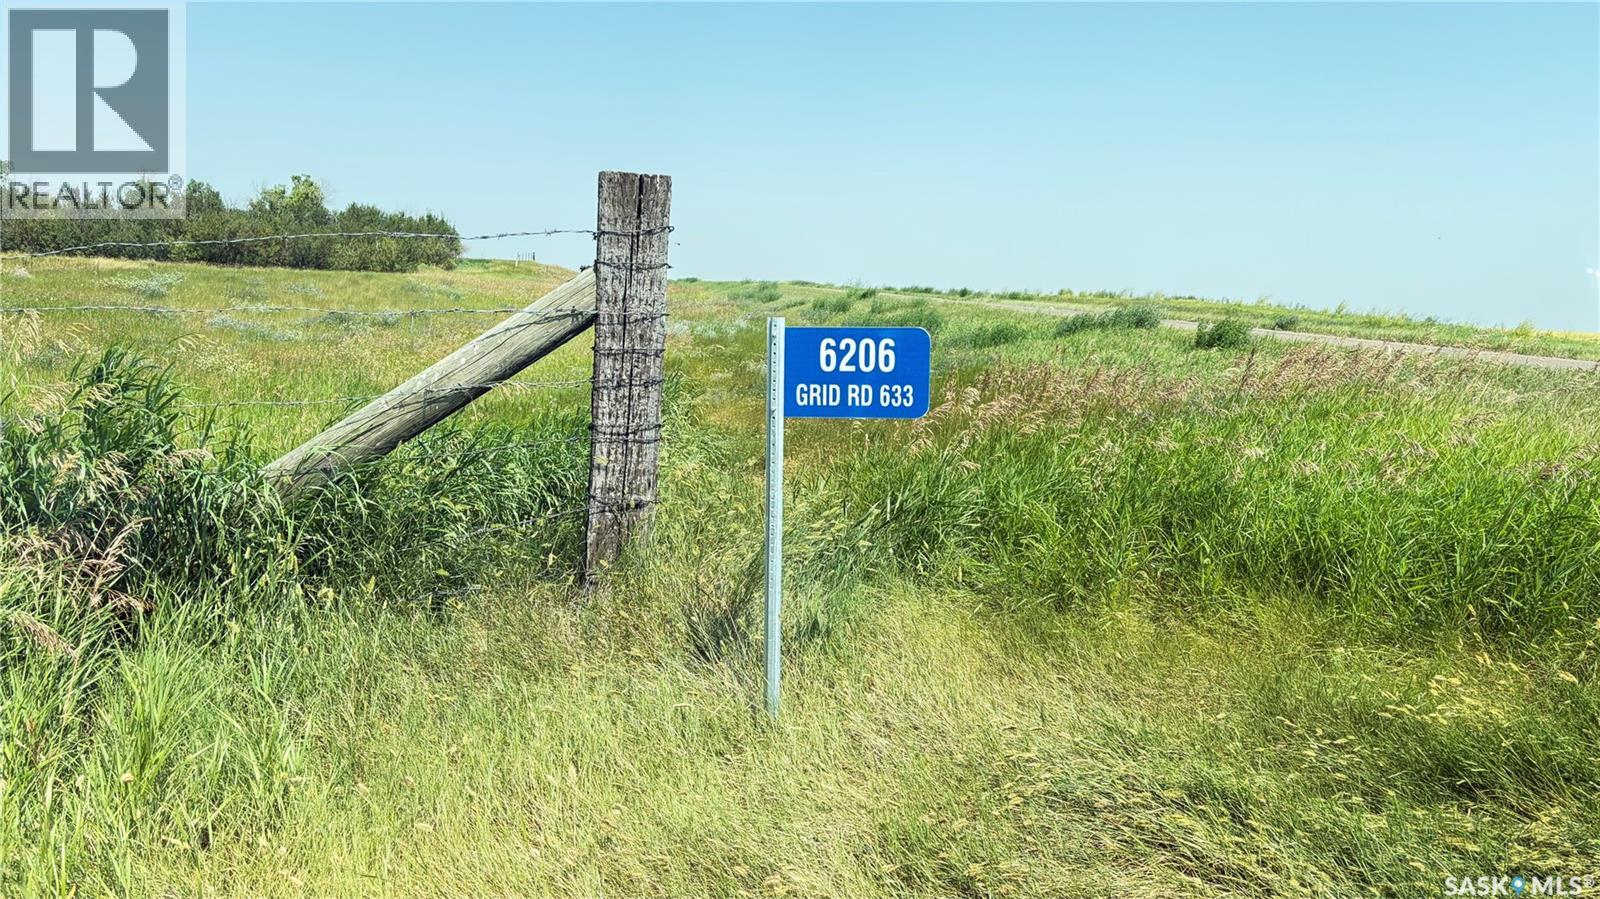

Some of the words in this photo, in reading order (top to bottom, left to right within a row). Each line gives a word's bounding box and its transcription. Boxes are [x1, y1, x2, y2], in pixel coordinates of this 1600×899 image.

[819, 338, 895, 373] 6206
[796, 384, 840, 406] GRID
[848, 384, 873, 406] RD
[880, 385, 914, 407] 633
